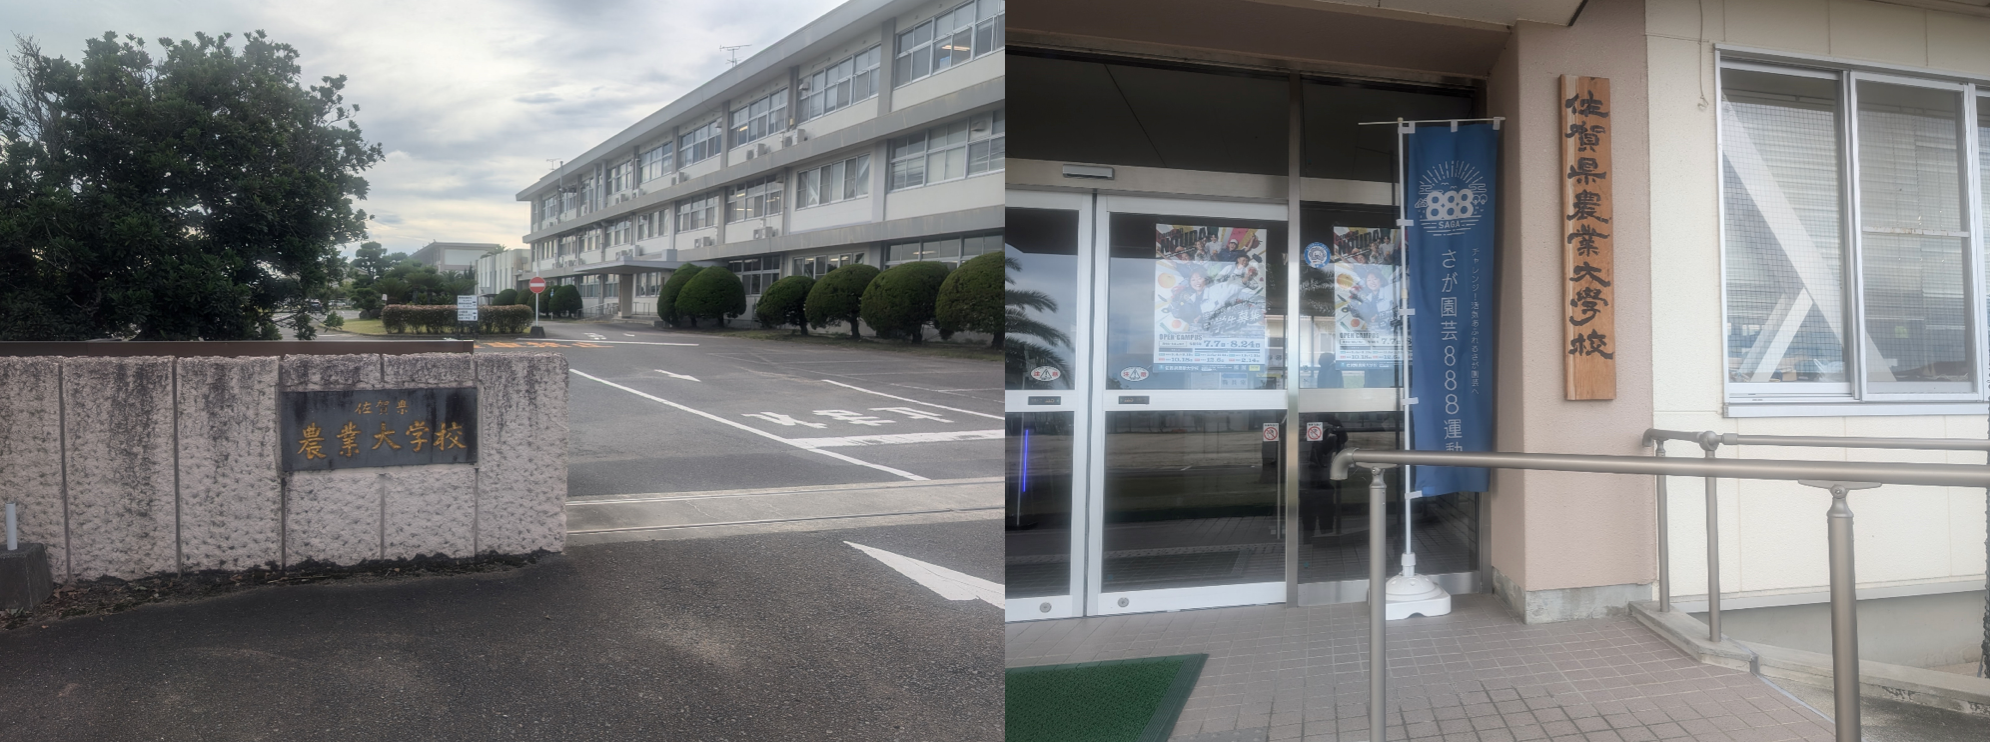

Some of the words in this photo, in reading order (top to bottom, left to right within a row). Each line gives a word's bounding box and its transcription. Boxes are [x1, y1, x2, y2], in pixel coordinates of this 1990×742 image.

[1426, 188, 1474, 220] 888
[1438, 220, 1461, 229] SAGA
[354, 399, 409, 415] 佐賀県
[297, 420, 467, 460] 農業大学校
